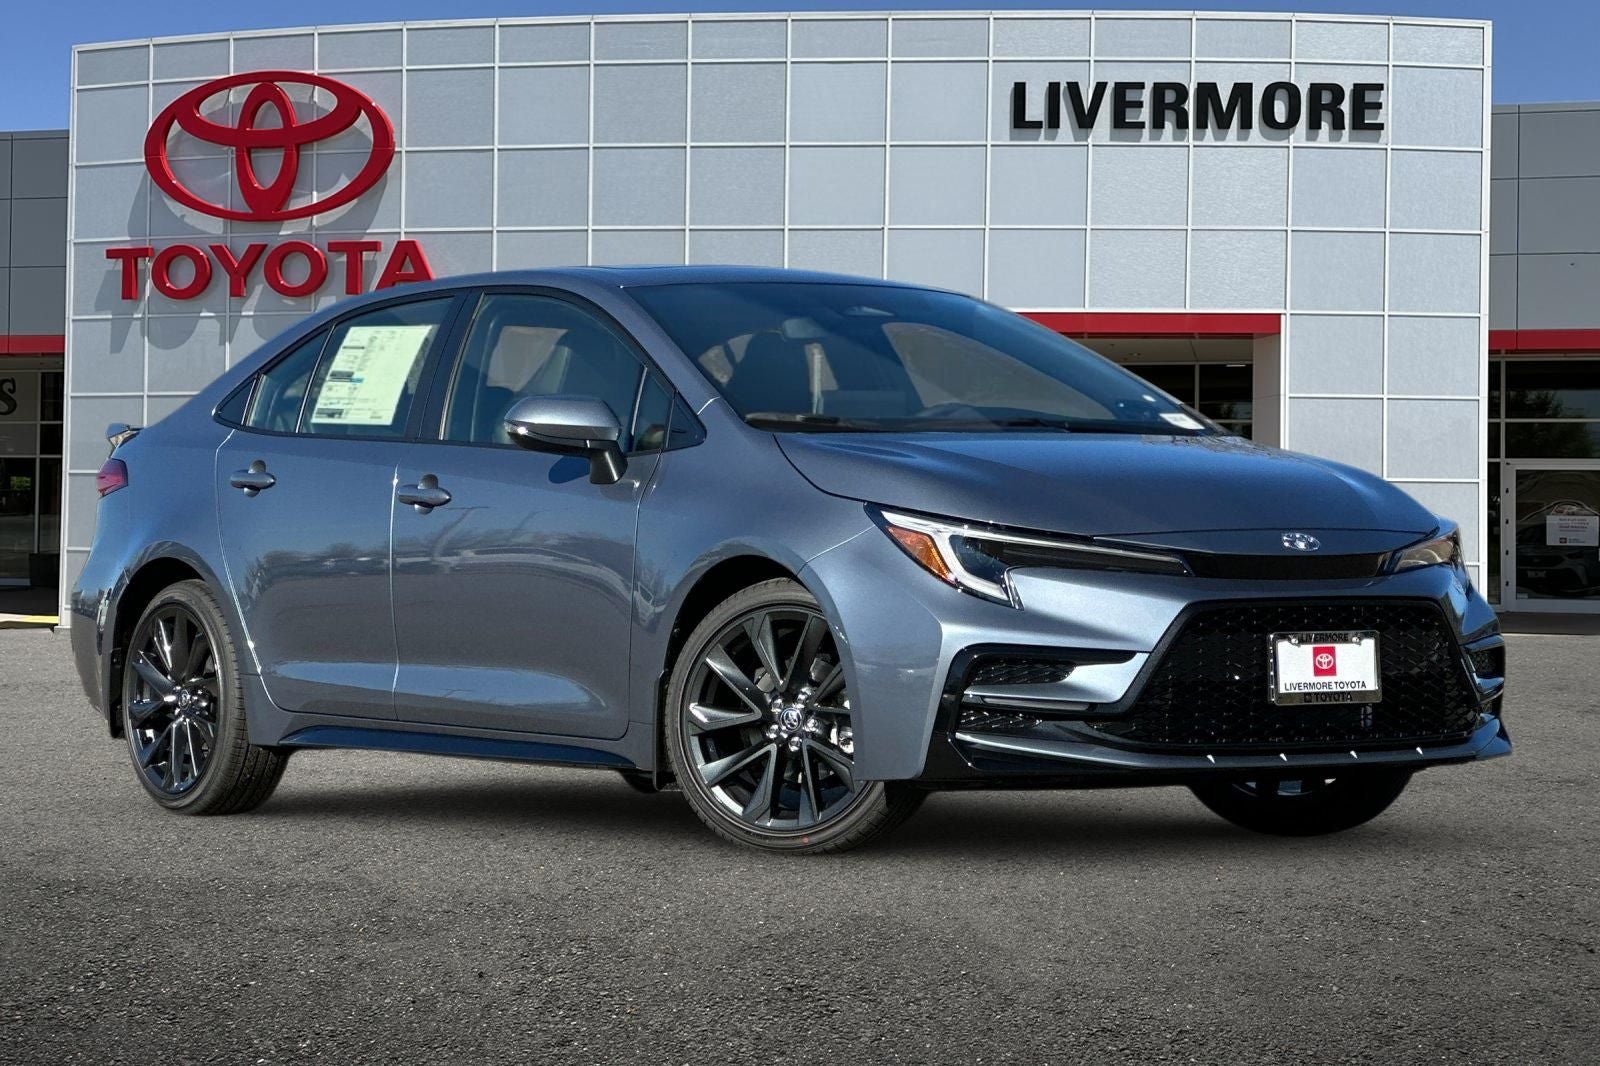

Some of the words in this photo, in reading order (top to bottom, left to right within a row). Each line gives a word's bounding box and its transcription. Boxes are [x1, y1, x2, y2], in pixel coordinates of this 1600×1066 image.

[1013, 81, 1384, 130] LIVERMORE
[106, 240, 435, 299] TOYOTA
[1301, 633, 1349, 643] LIVERMORE
[1284, 682, 1335, 691] LIVERMORE
[1335, 681, 1367, 690] TOYOTA
[1313, 692, 1353, 702] TOYOTA
